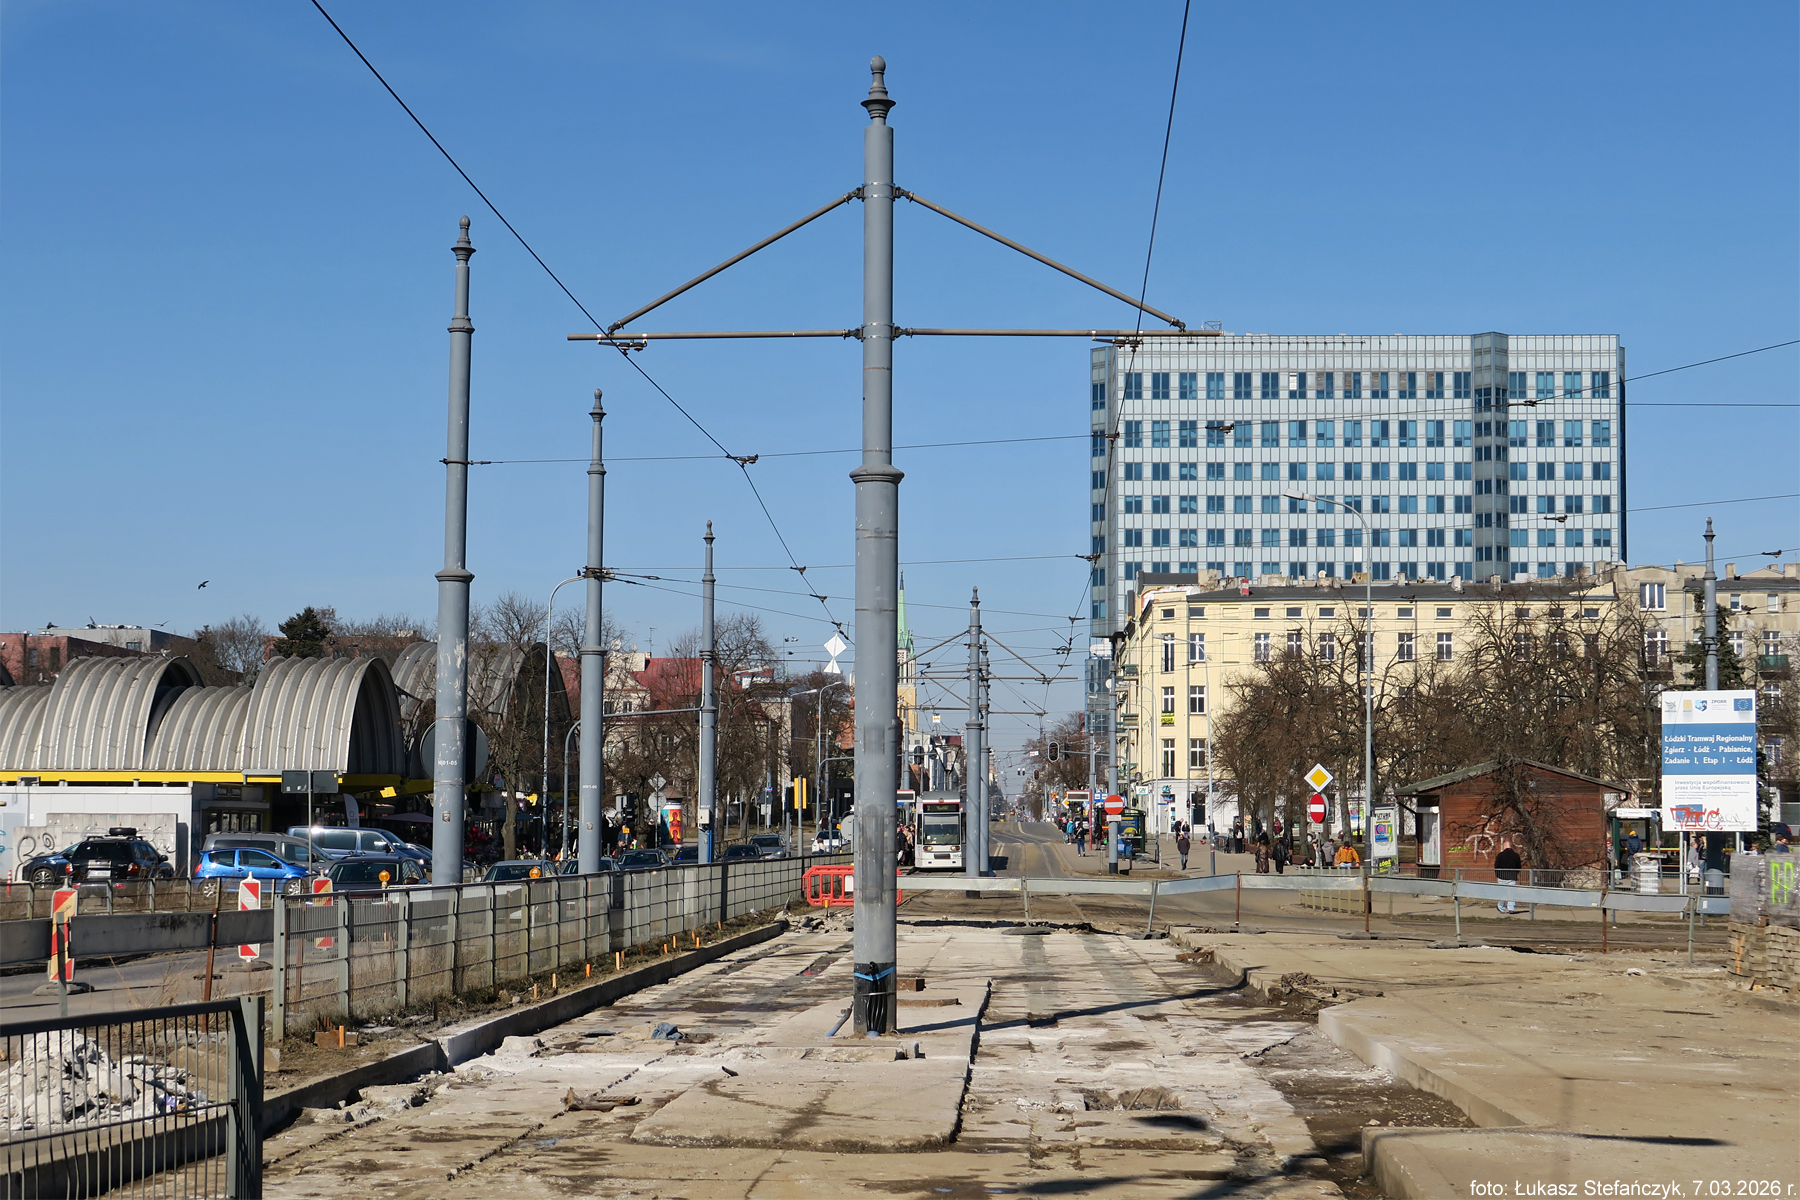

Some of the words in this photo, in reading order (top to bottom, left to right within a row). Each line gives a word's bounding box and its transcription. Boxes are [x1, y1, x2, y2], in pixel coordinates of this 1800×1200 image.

[1688, 735, 1715, 743] Tramwaj
[1716, 734, 1753, 743] Regionalny
[1664, 746, 1685, 754] Zgierz
[1703, 757, 1718, 765] Etap
